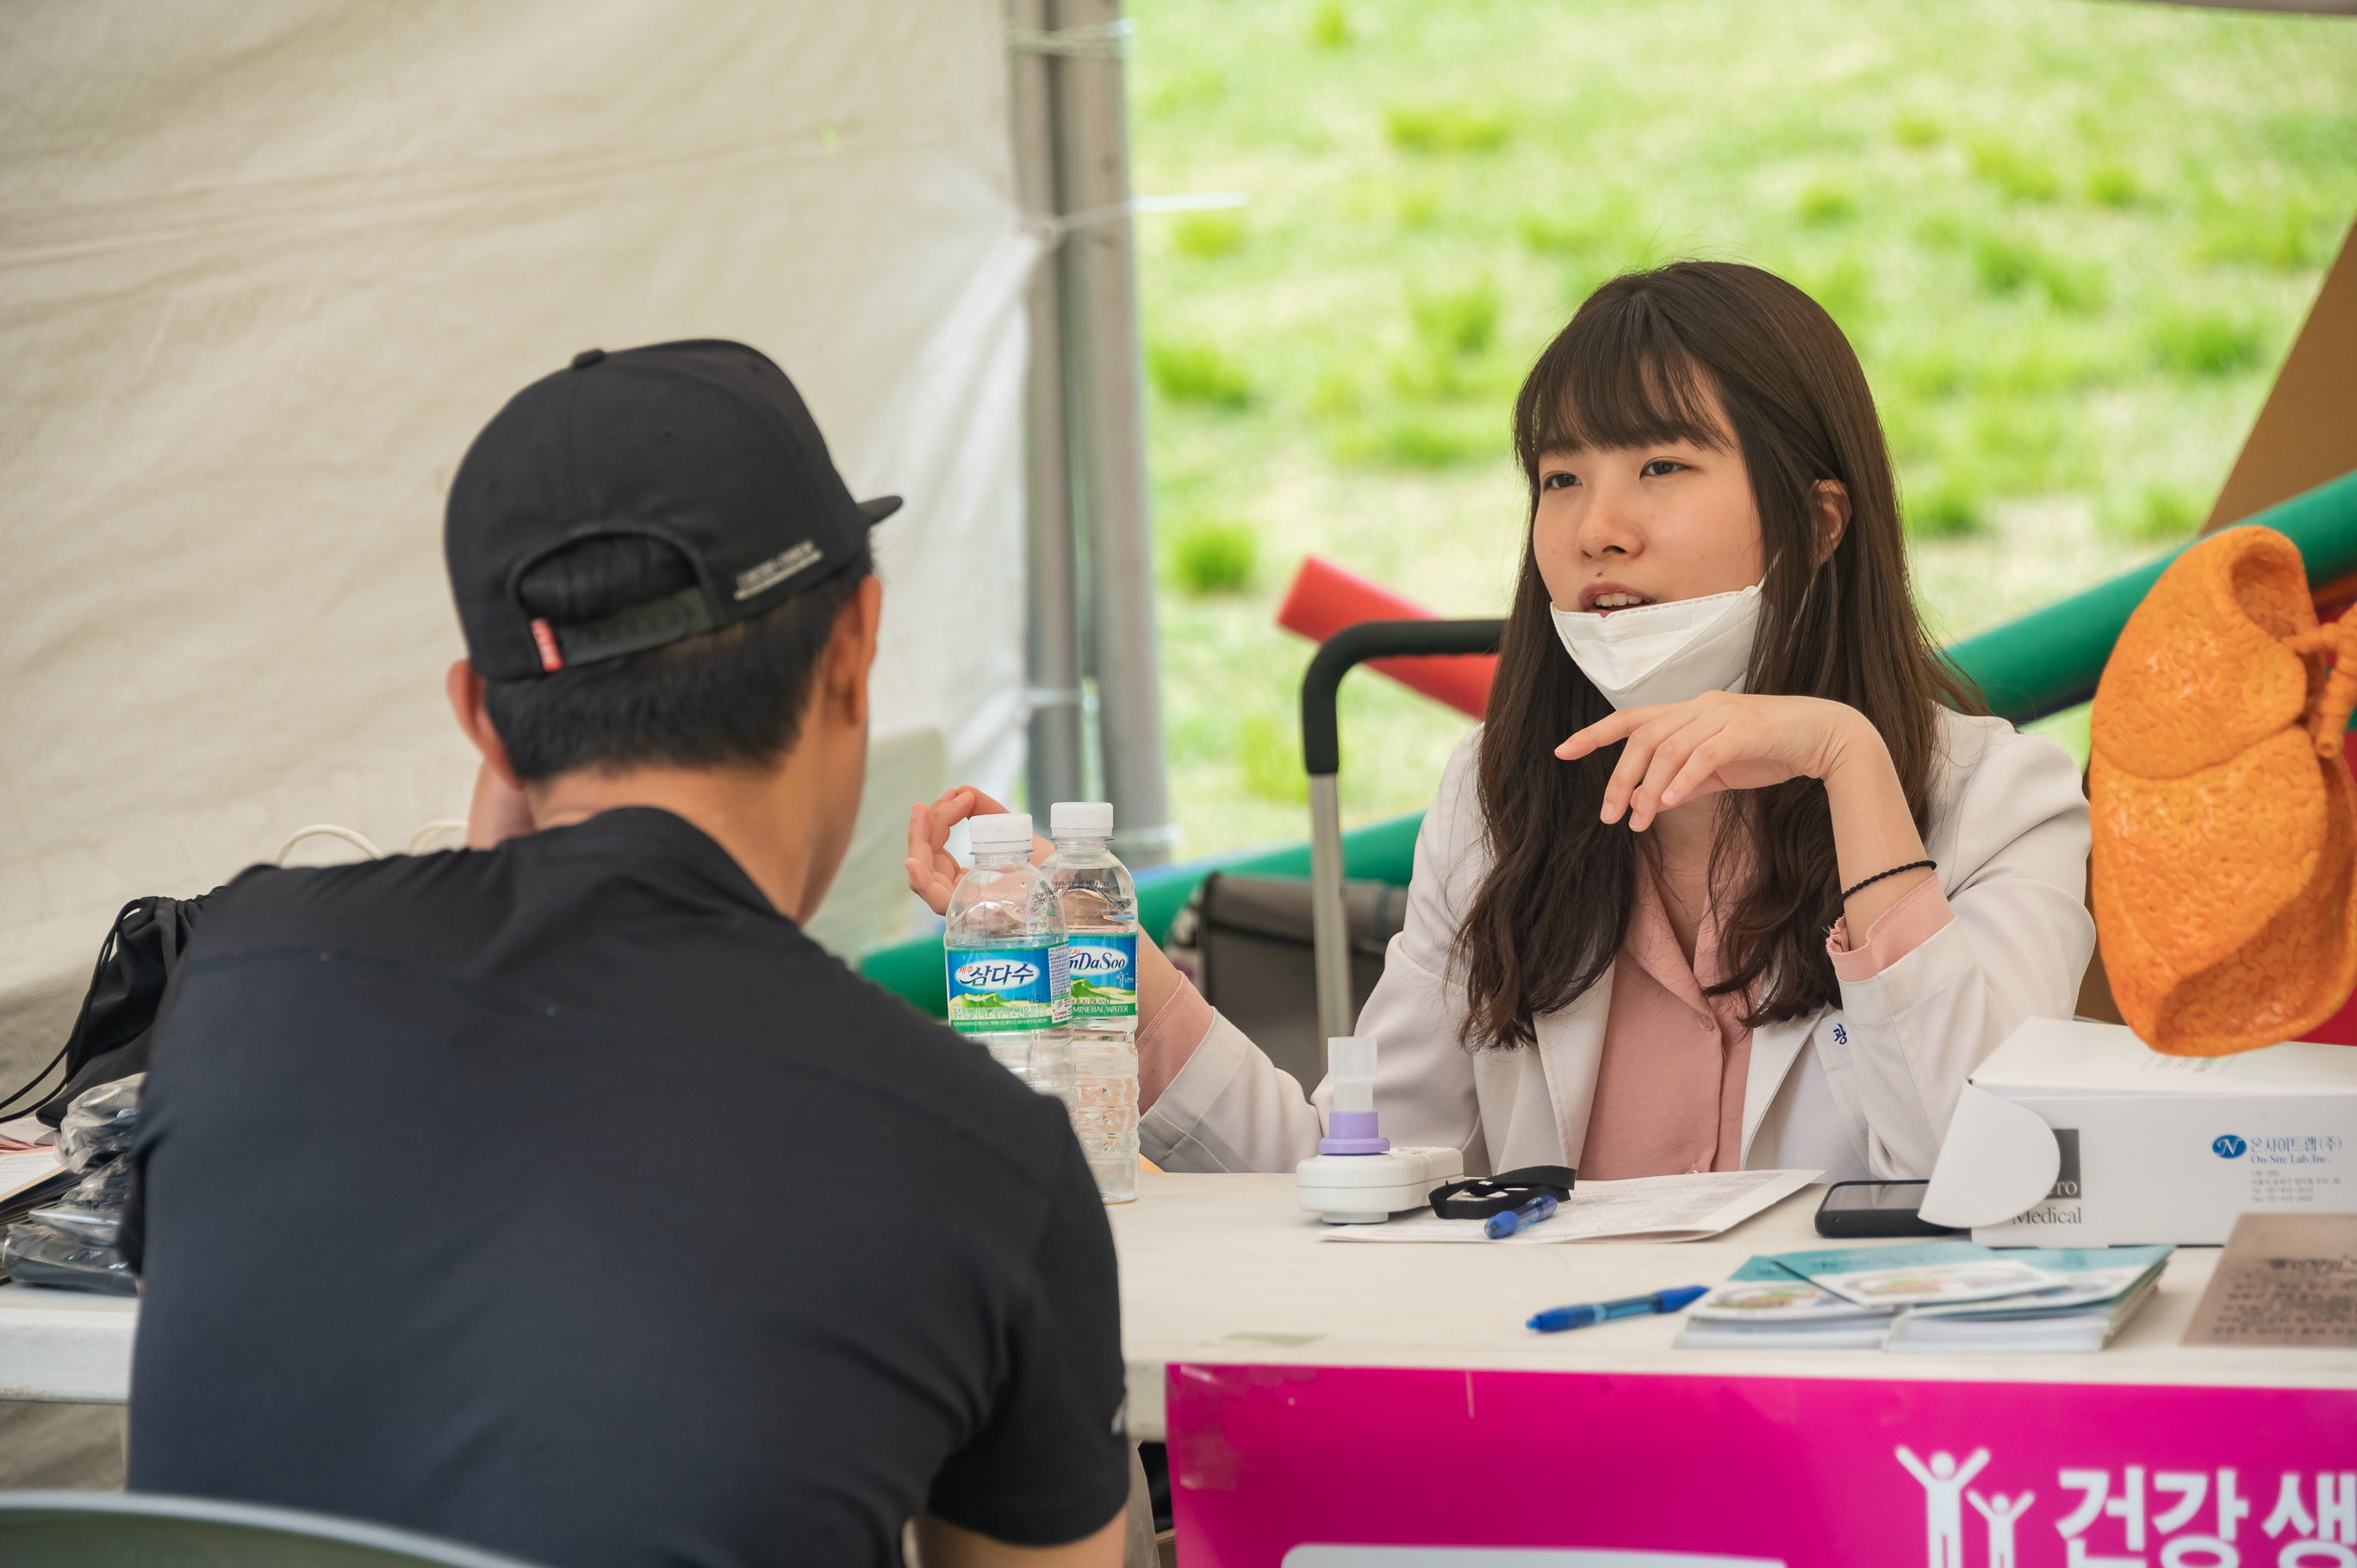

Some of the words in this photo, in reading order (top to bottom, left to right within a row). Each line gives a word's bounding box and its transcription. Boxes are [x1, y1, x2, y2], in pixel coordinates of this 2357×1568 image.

[959, 966, 973, 974] 제주
[961, 962, 1035, 986] 삼다수
[1105, 1005, 1129, 1013] WATER
[2055, 1465, 2250, 1568] 건강
